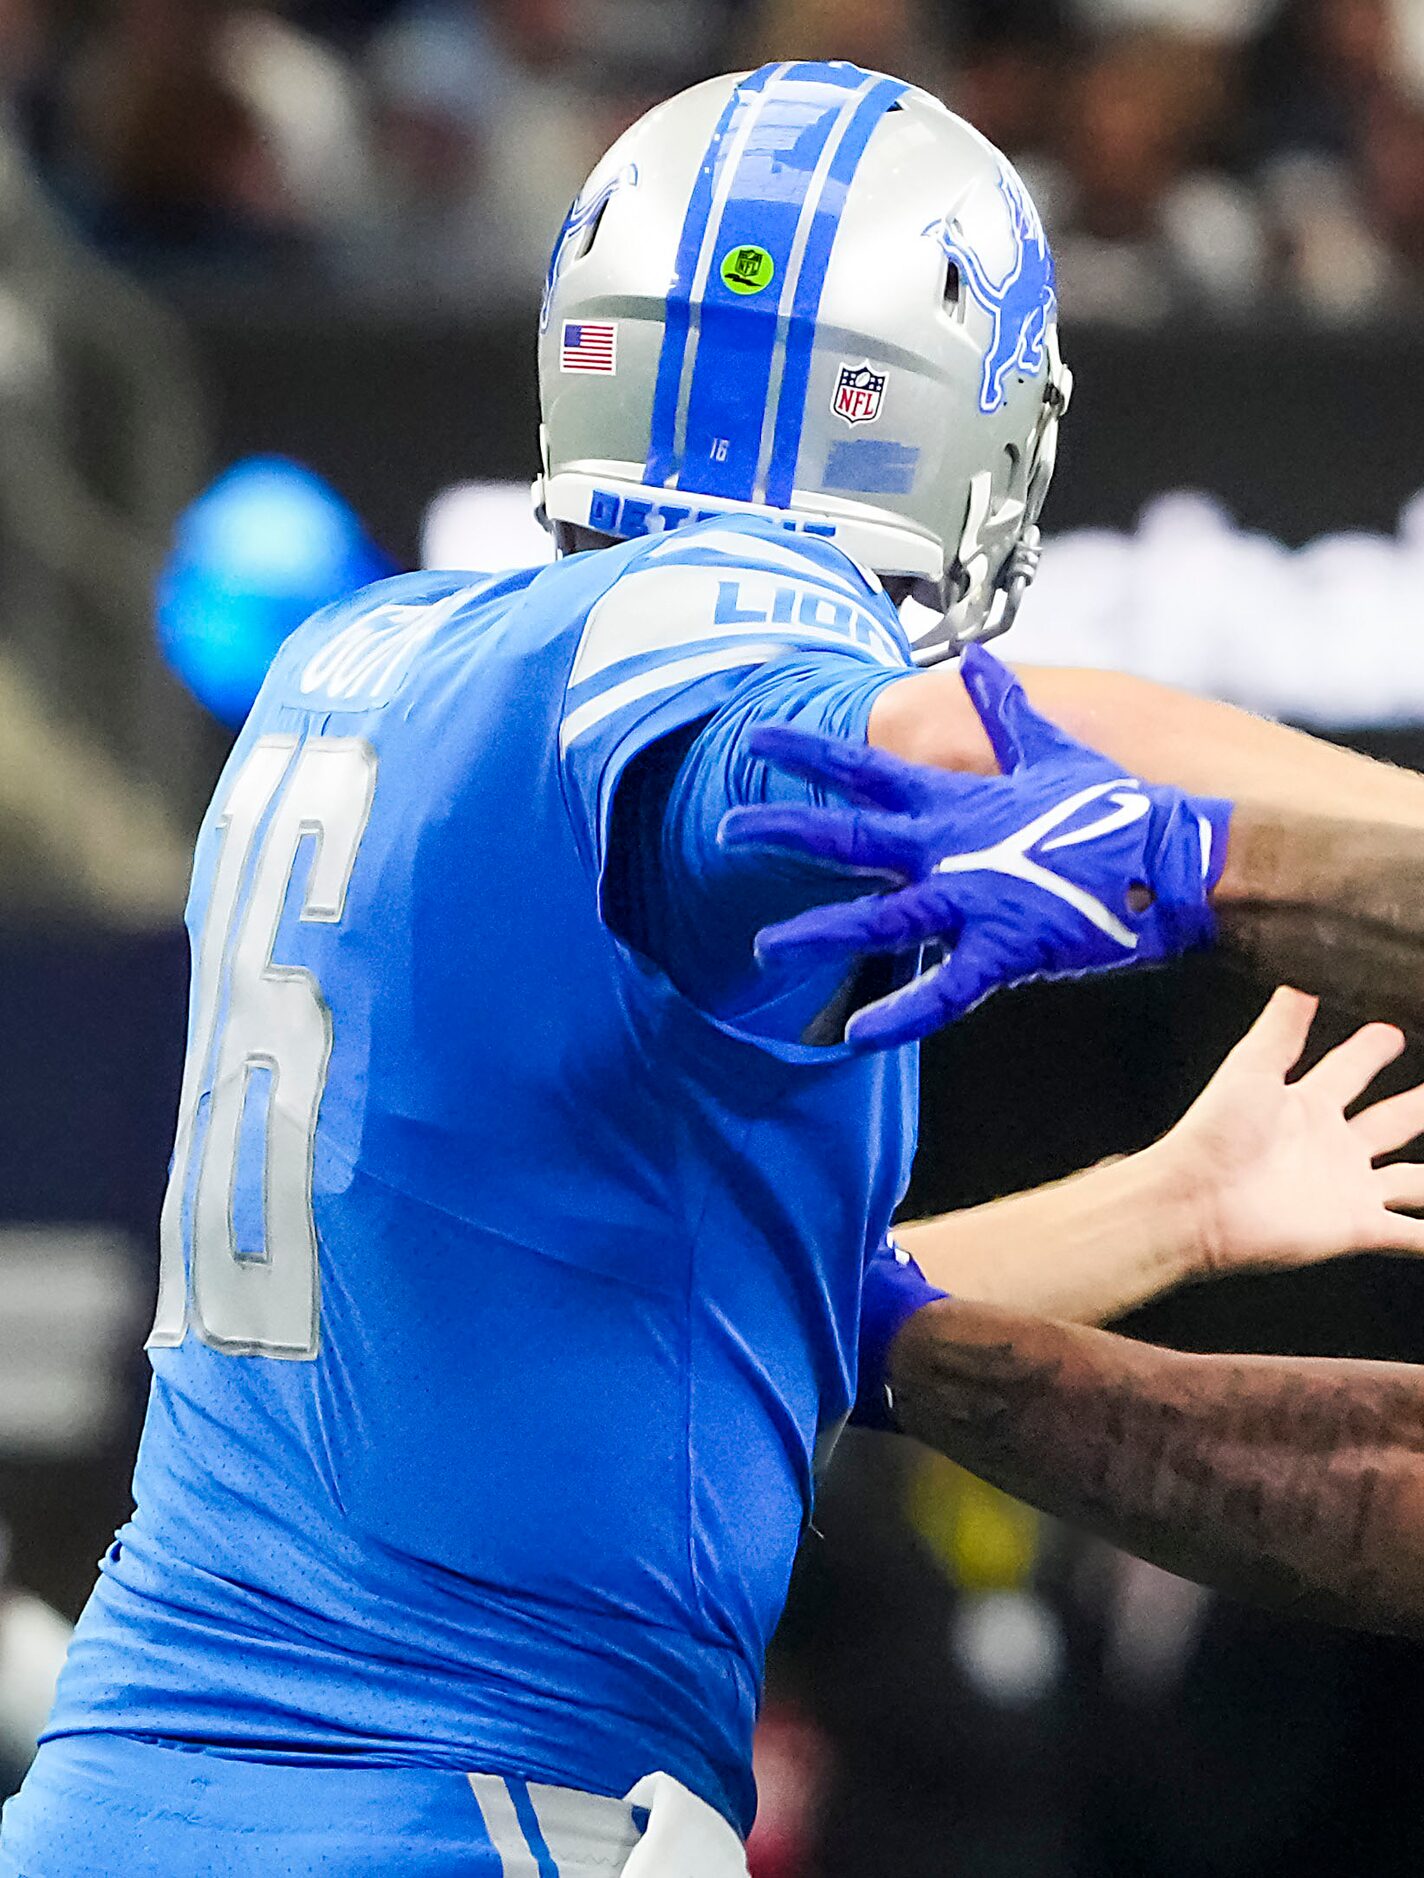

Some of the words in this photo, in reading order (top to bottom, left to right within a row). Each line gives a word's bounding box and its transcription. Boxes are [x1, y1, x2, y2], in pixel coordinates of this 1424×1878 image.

[737, 260, 758, 276] NFL
[838, 387, 874, 416] NFL
[709, 438, 730, 462] 16
[144, 735, 377, 1361] 16
